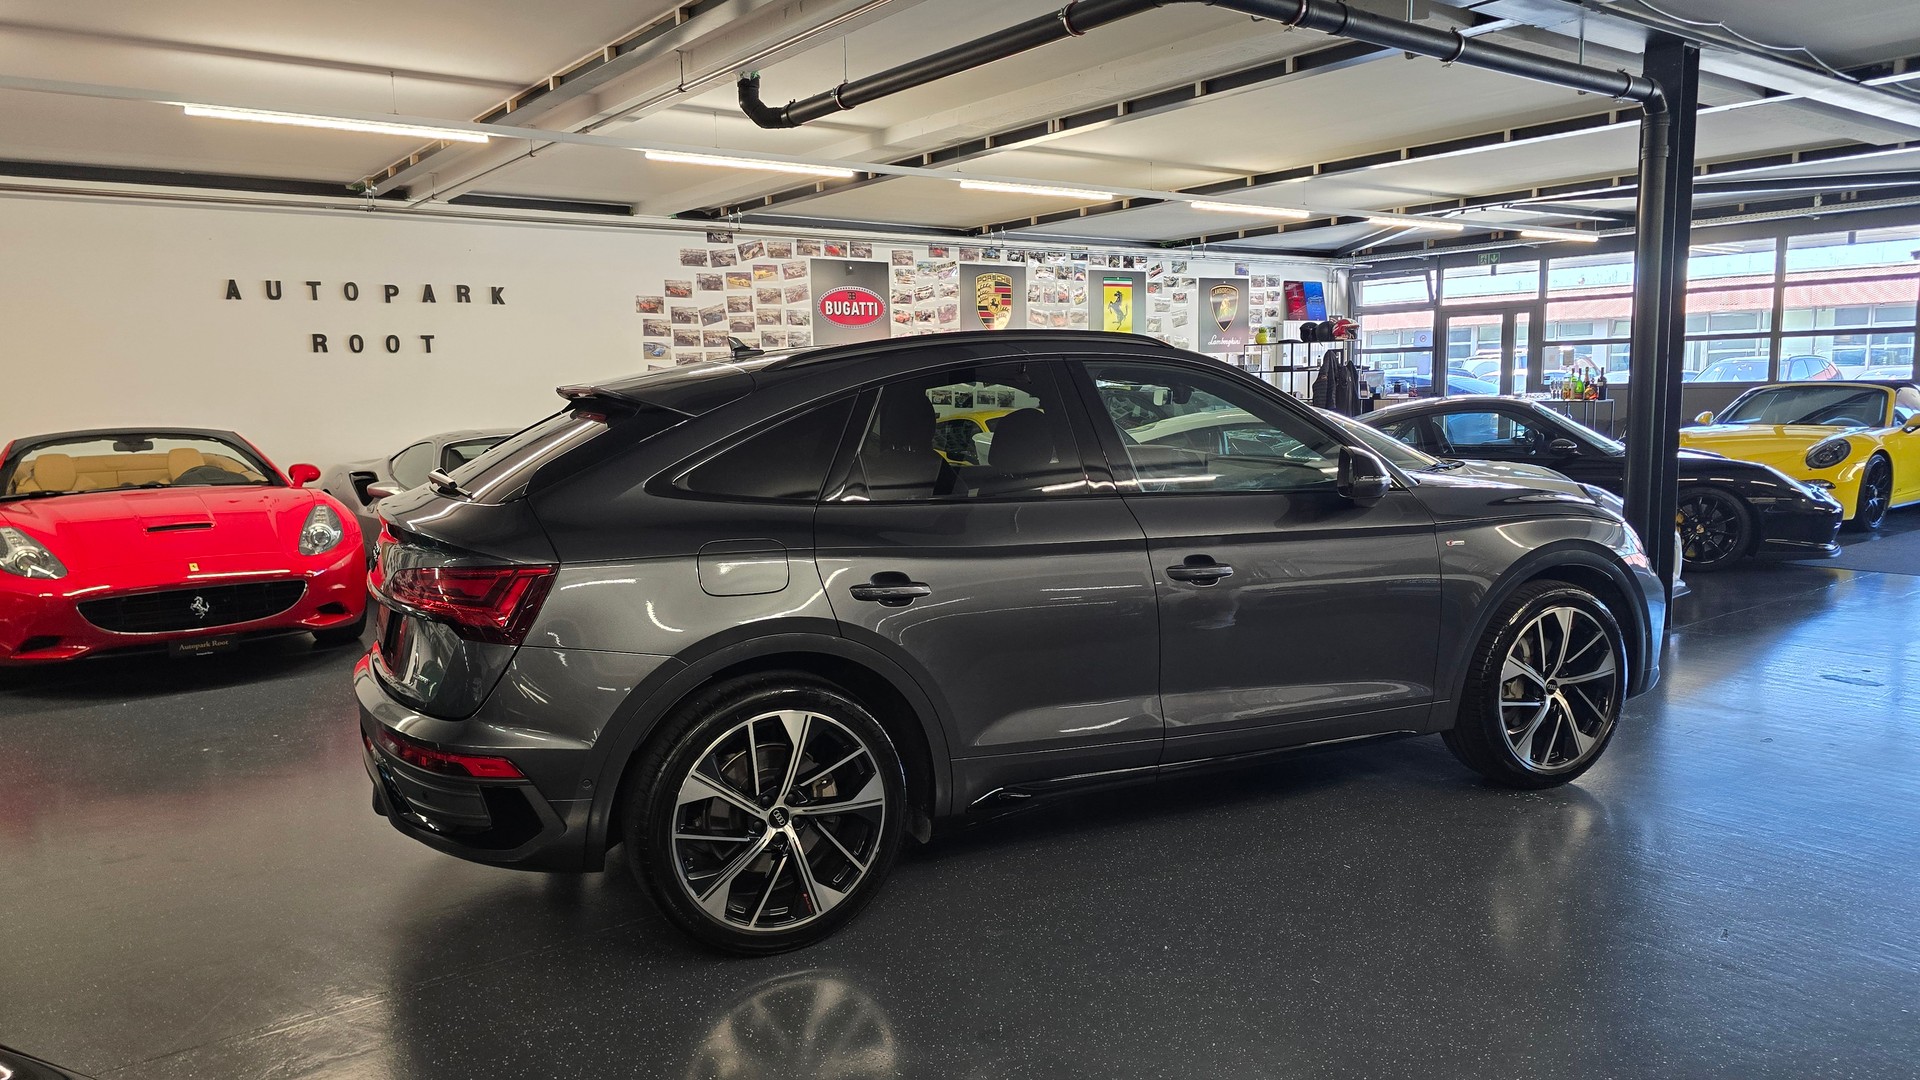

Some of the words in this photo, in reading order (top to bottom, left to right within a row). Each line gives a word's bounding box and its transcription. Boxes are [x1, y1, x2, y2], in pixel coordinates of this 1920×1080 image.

[976, 274, 1012, 284] PORSCHE
[225, 279, 505, 305] AUTOPARK
[825, 300, 878, 316] BUGATTI
[311, 333, 435, 353] ROOT
[1207, 334, 1242, 347] Lamborghini
[179, 641, 211, 650] Autopark
